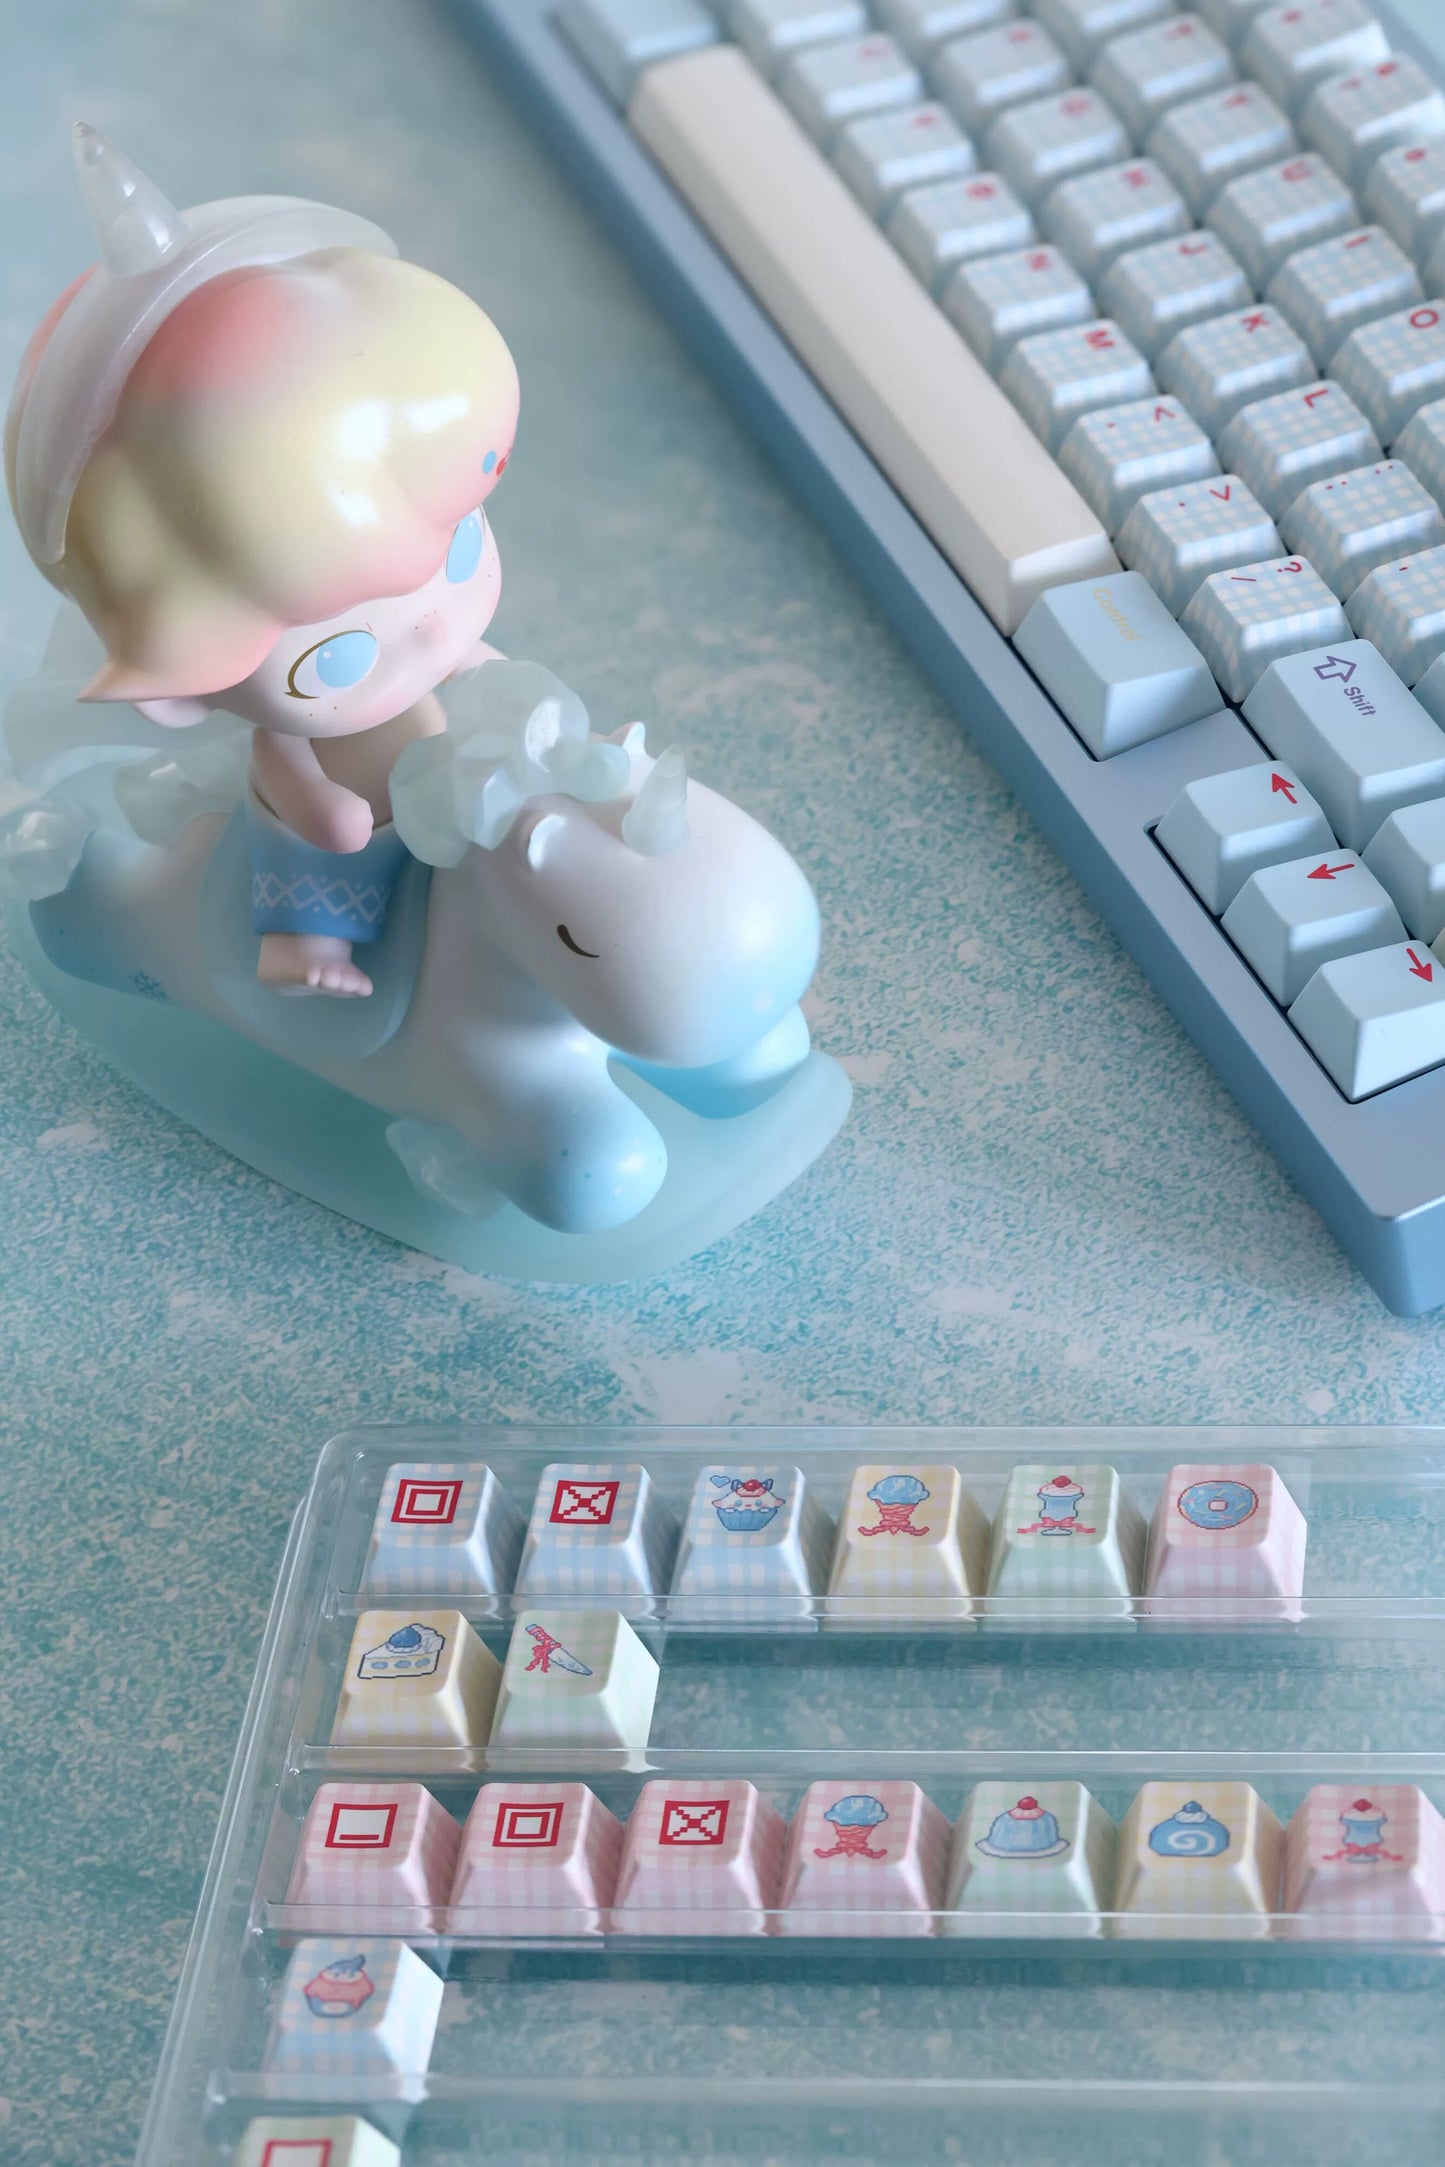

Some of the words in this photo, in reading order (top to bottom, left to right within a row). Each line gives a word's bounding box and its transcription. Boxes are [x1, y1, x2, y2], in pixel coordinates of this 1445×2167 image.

[1241, 312, 1270, 334] K
[1408, 308, 1440, 330] O
[1083, 328, 1117, 350] M
[1303, 388, 1329, 410] L
[1277, 561, 1303, 574] ?
[1092, 587, 1141, 641] Control
[1343, 686, 1376, 715] Shift
